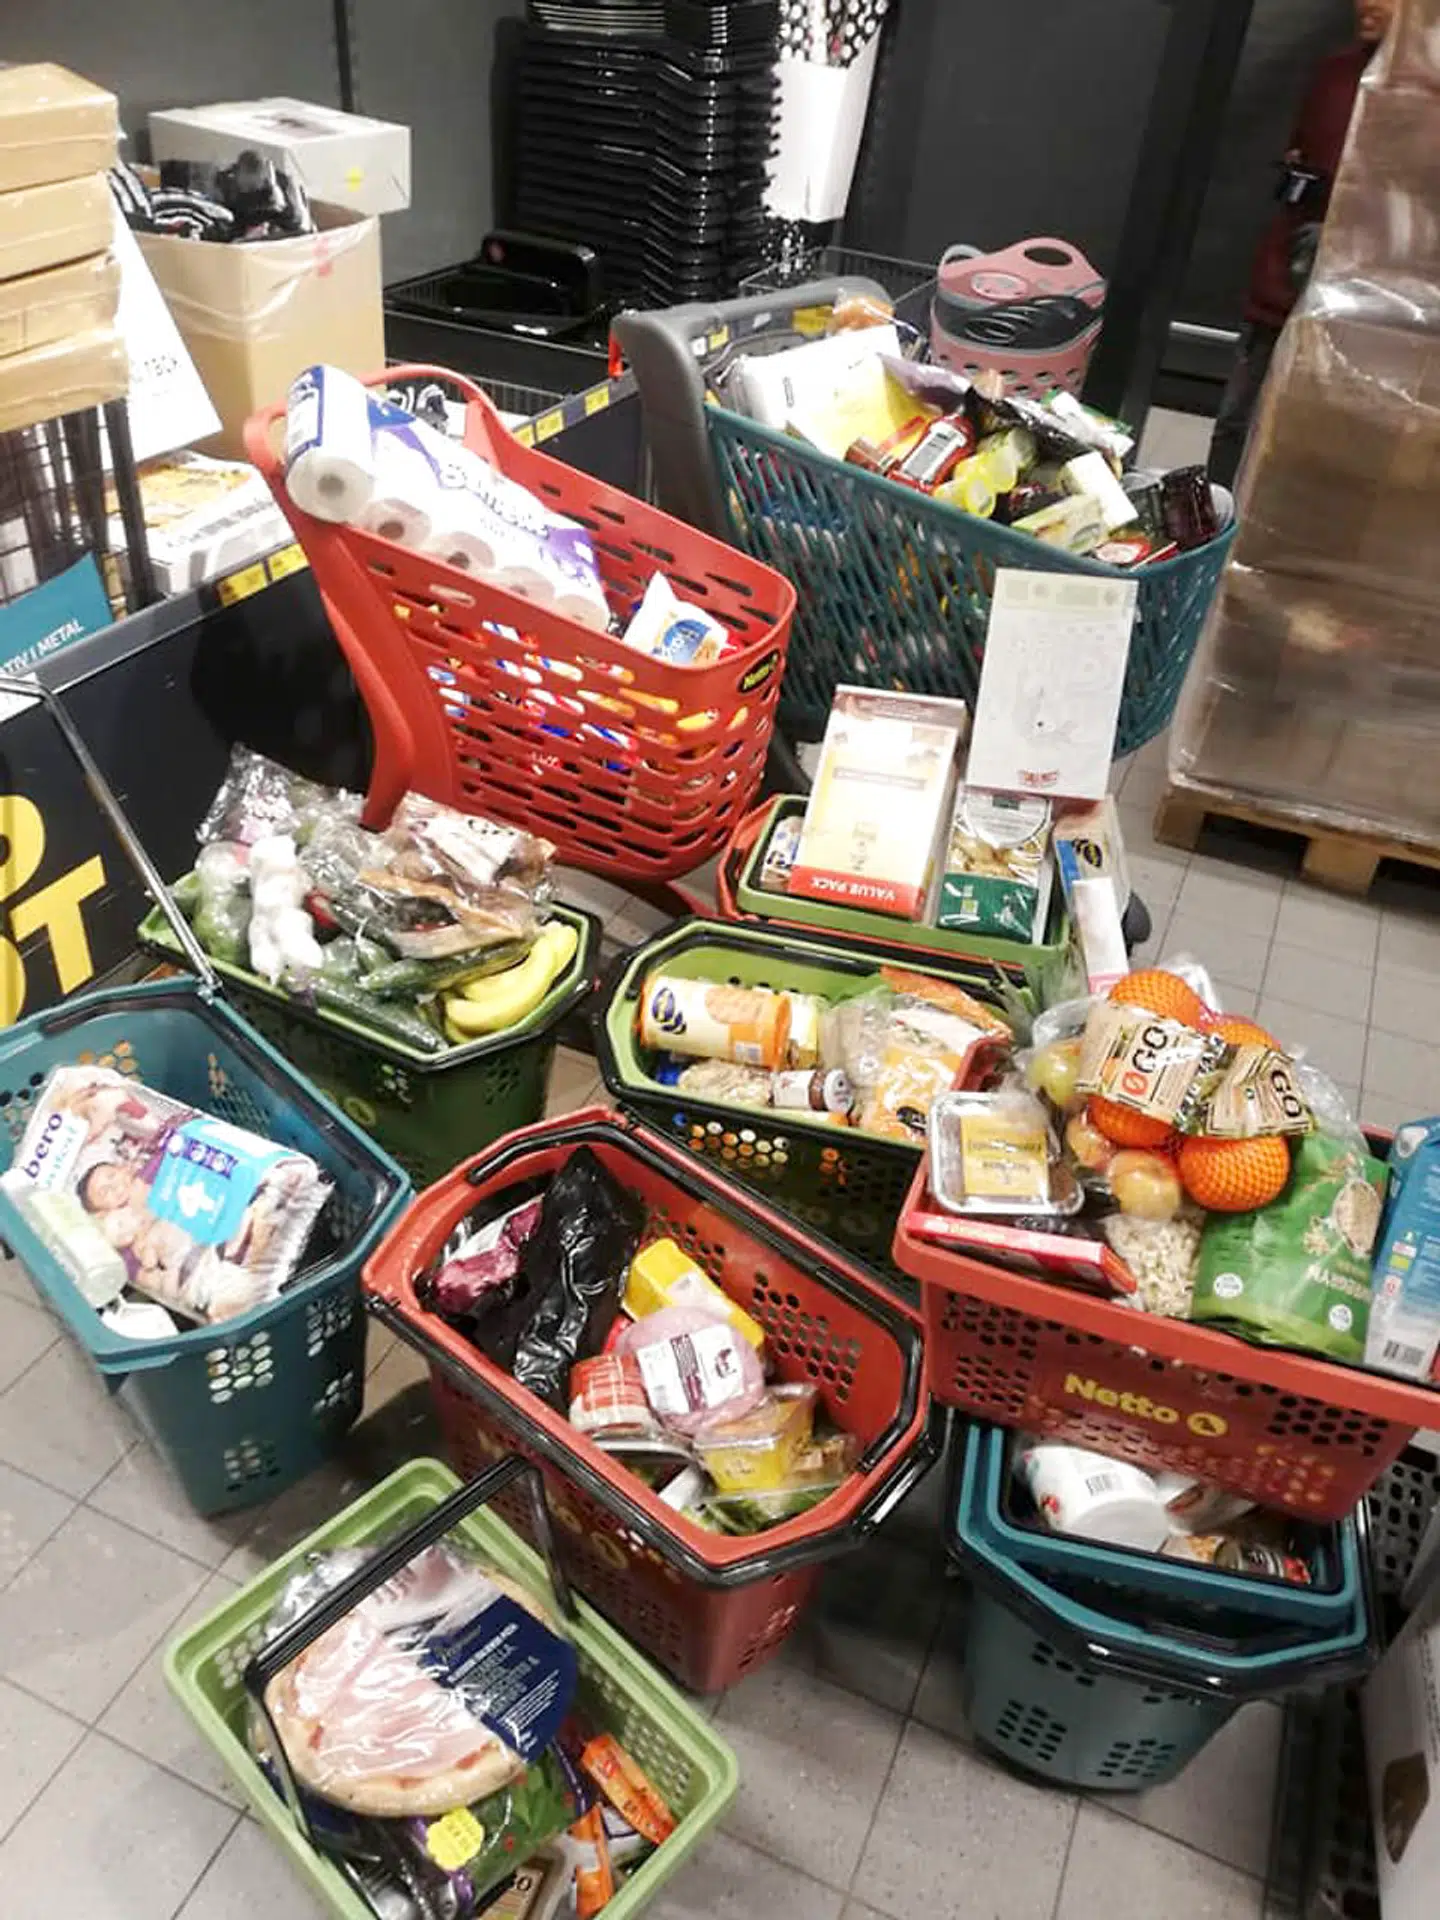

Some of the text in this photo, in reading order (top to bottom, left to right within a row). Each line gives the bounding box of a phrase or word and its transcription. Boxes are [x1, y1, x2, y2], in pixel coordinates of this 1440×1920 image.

[37, 617, 84, 656] METAL
[810, 875, 897, 901] VALUE PACK
[1064, 1372, 1180, 1425] Netto
